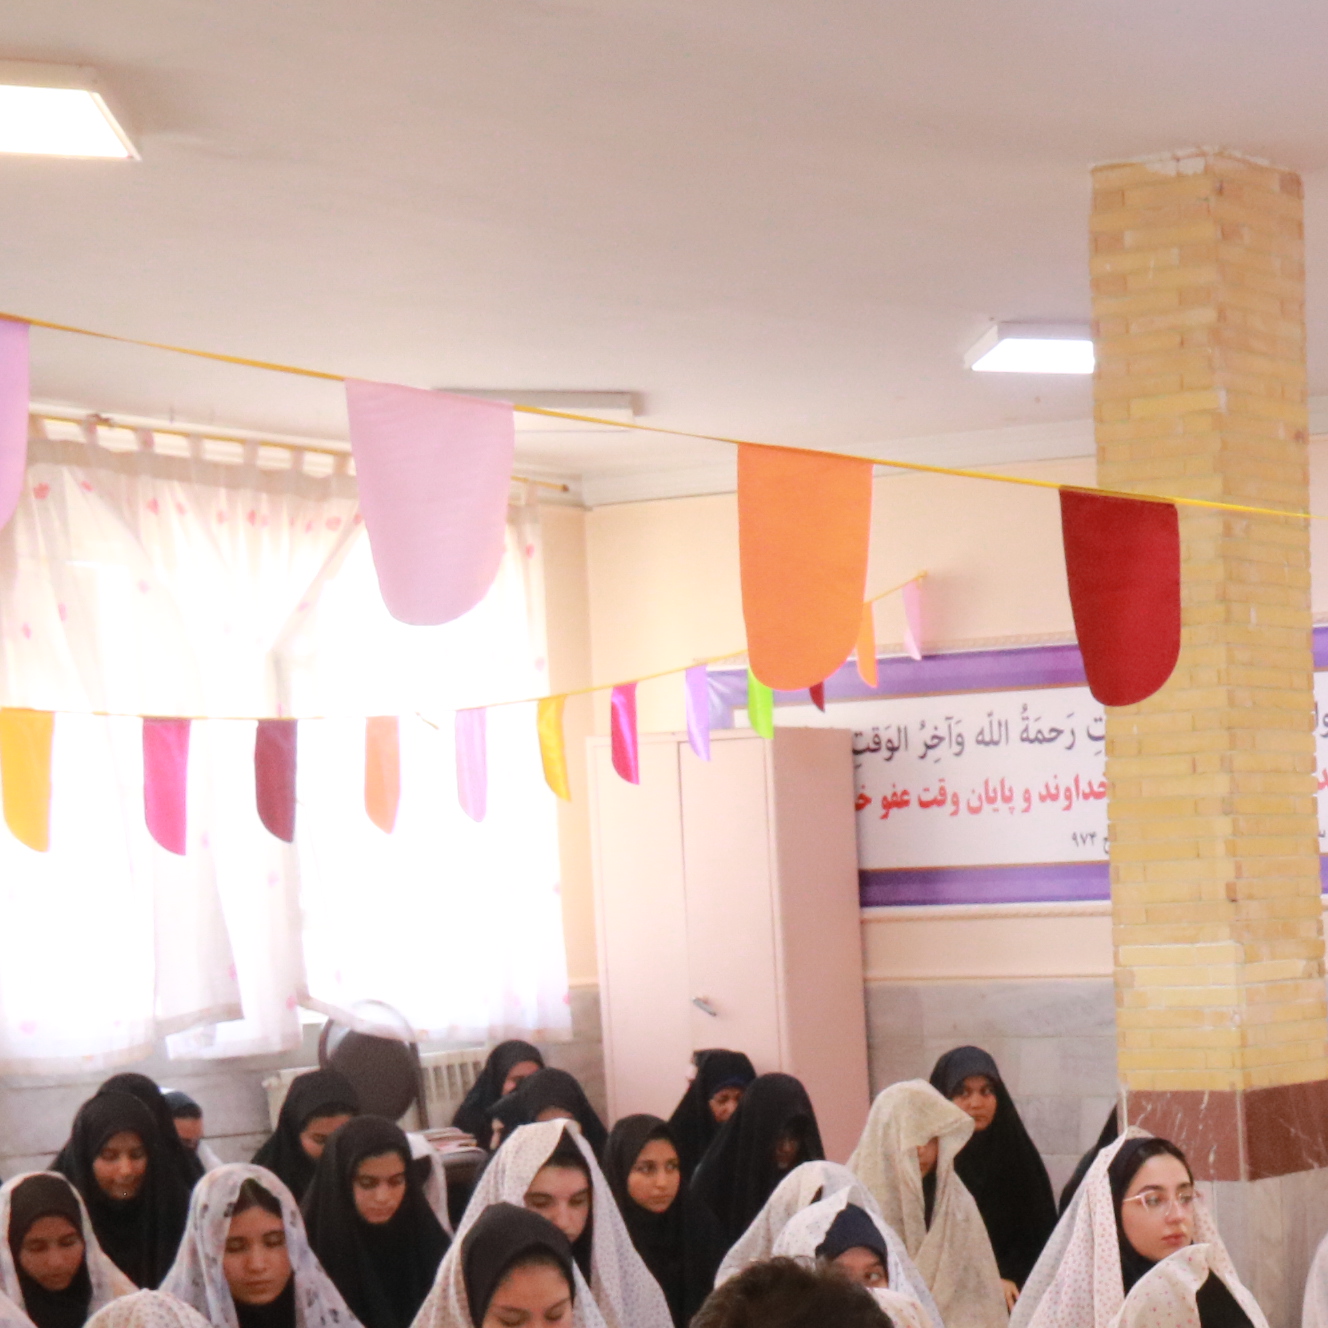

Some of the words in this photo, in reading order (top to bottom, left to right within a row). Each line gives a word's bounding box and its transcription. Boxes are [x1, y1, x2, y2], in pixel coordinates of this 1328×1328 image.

[880, 782, 911, 820] عفو
[918, 777, 960, 817] وقت
[967, 776, 1015, 815] پایان
[1021, 786, 1033, 812] و
